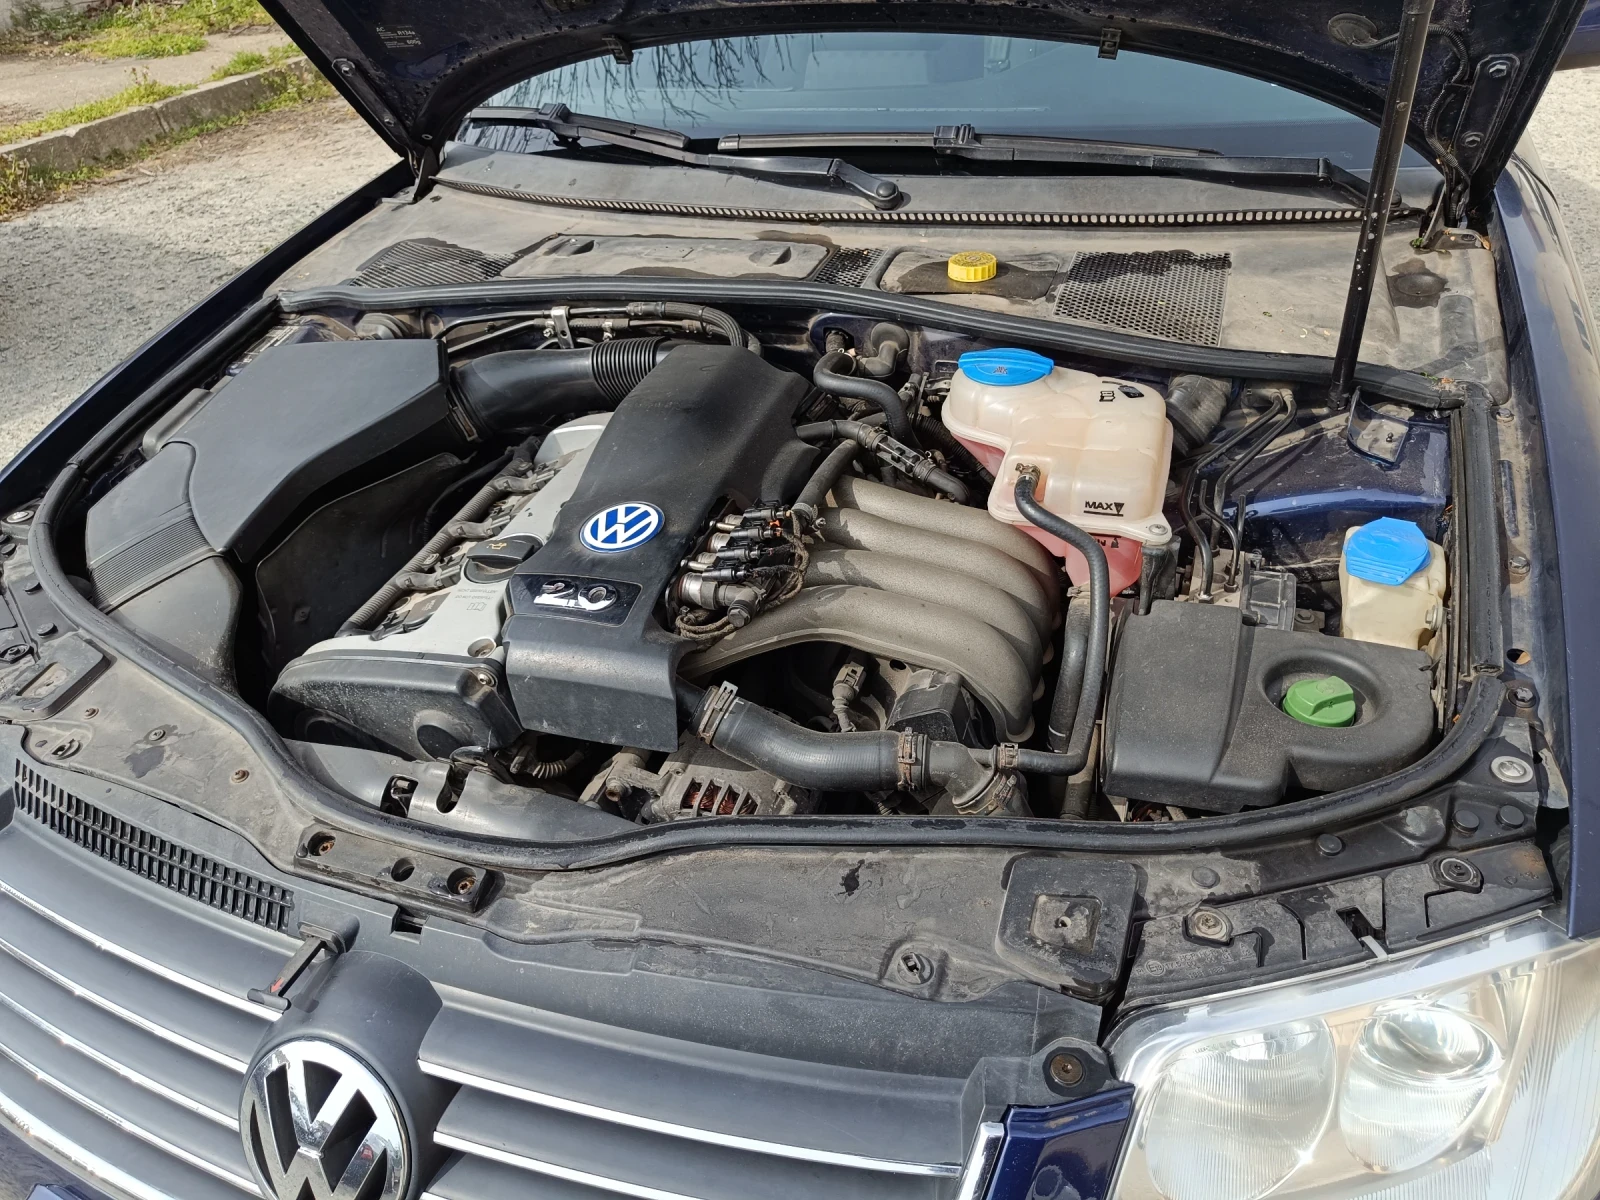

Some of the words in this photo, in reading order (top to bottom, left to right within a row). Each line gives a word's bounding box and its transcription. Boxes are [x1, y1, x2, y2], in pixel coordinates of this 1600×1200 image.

[582, 502, 662, 552] VW
[1085, 500, 1113, 511] MAX
[241, 1040, 411, 1200] VW
